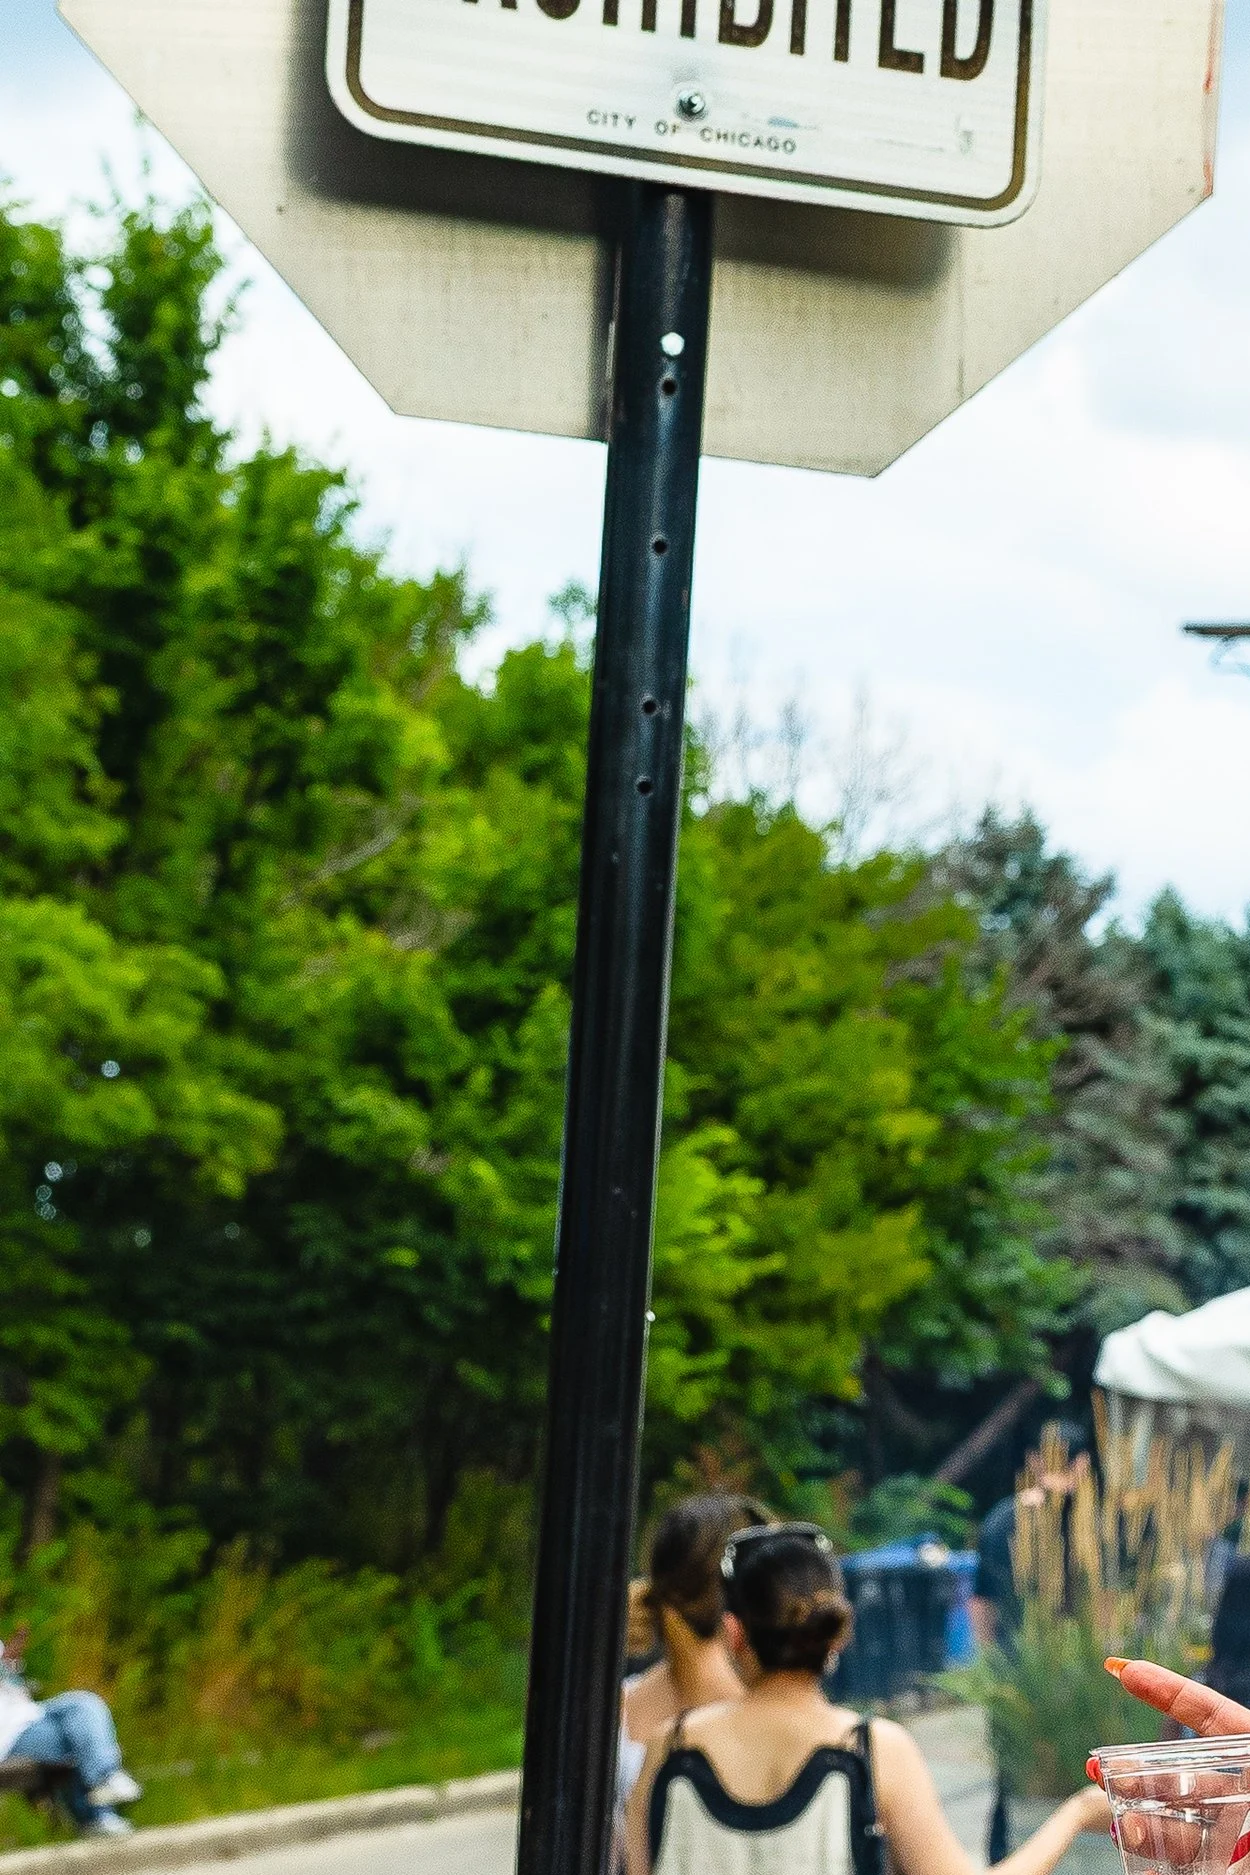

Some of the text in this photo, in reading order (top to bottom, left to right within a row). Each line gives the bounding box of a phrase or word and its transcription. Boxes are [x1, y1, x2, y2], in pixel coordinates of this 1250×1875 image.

[587, 109, 797, 155] CITY OF CHICAGO
